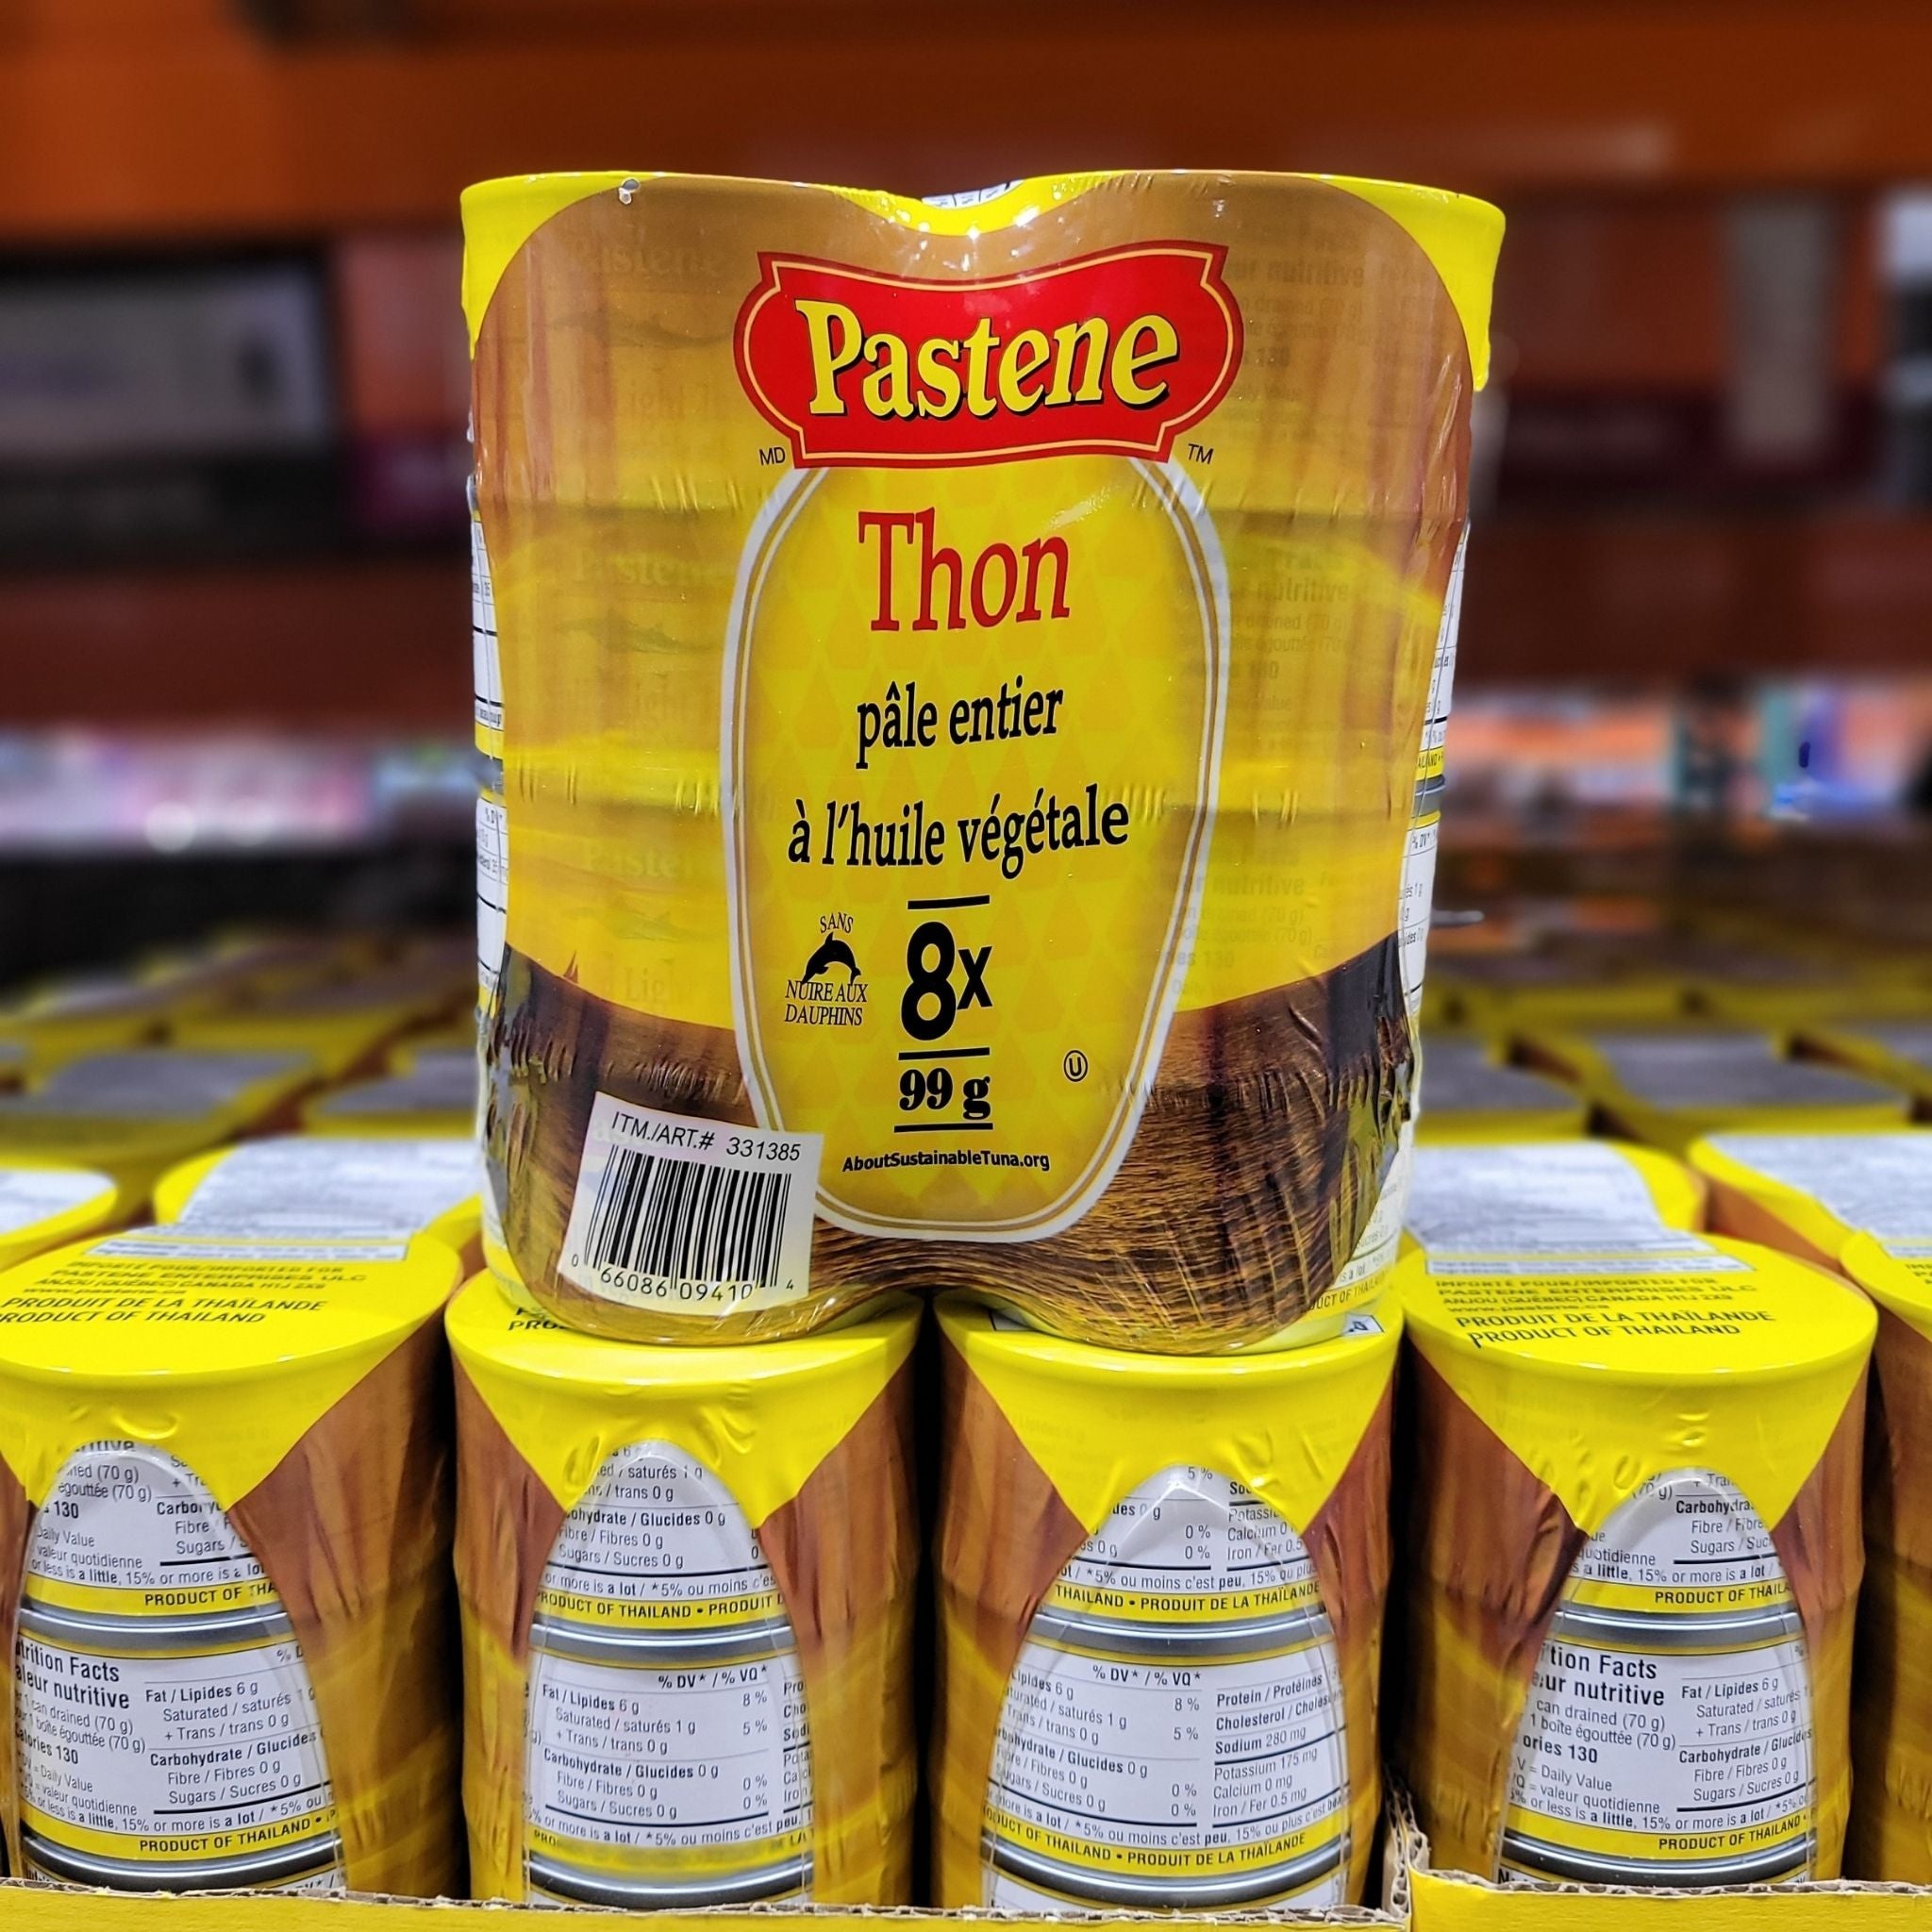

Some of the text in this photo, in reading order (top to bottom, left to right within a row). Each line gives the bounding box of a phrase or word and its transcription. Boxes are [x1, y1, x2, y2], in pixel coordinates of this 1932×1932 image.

[795, 299, 1179, 420] Pastene
[759, 446, 785, 465] MD
[1187, 444, 1213, 464] TM
[858, 507, 1070, 631] Thon
[856, 675, 1063, 769] pâle entier
[788, 783, 1129, 879] à l'huile végétale
[820, 912, 854, 933] SANS
[785, 979, 868, 1003] NUIRE AUX
[785, 1004, 862, 1025] DAUPHINS
[899, 1067, 991, 1121] 99 g
[611, 1111, 801, 1160] ITM./ART.# 331385
[842, 1149, 1049, 1173] AboutSustainableTuna.org
[572, 1254, 793, 1300] 0 66086 09410 4
[2, 1297, 326, 1311] PRODUIT DE LA THAÏLANDE
[106, 1312, 138, 1321] OF
[143, 1311, 266, 1323] THAILAND
[1457, 1310, 1775, 1327] PRODUIT DE LA THAÏLANDE
[1469, 1324, 1740, 1348] PRODUCT OF THAILAND
[627, 1466, 677, 1479] saturés
[616, 1486, 648, 1500] trans
[55, 1500, 79, 1519] 130
[641, 1511, 701, 1527] Glucides
[175, 1520, 209, 1534] Fibre
[600, 1529, 638, 1546] Fibres
[1227, 1521, 1275, 1541] Calcium
[1691, 1520, 1723, 1534] Fibre
[64, 1531, 94, 1547] Value
[176, 1540, 225, 1556] Sugars
[1690, 1540, 1735, 1556] Sugars
[72, 1553, 142, 1569] quotidienne
[558, 1544, 658, 1568] Sugars Sucres
[1227, 1543, 1252, 1560] Iron
[127, 1572, 213, 1584] 15% more
[1121, 1571, 1275, 1590] ou moins c'est 15%
[1639, 1569, 1666, 1582] 15%
[1672, 1572, 1687, 1583] or
[1690, 1568, 1722, 1582] more
[1726, 1567, 1736, 1580] is
[1740, 1568, 1746, 1579] a
[1750, 1565, 1765, 1578] lot
[145, 1585, 242, 1606] PRODUCT OF
[560, 1574, 748, 1596] more lot ou moins
[1056, 1581, 1320, 1611] THAILAND PRODUIT DE LA THAÏLANDE
[1656, 1590, 1744, 1604] PRODUCT OF
[597, 1596, 773, 1618] OF THAILAND PRODUIT
[71, 1657, 120, 1682] Facts
[1599, 1655, 1657, 1679] Facts
[54, 1683, 129, 1709] nutritive
[146, 1686, 232, 1703] Fat Lipides
[1216, 1674, 1323, 1707] Protein Protéines
[1574, 1680, 1664, 1706] nutritive
[1681, 1680, 1759, 1699] Fat Lipides
[50, 1707, 90, 1727] drained
[163, 1702, 228, 1723] Saturated
[556, 1707, 671, 1733] Saturated saturés
[1216, 1708, 1285, 1731] Cholesterol
[1565, 1706, 1617, 1725] drained
[1696, 1703, 1755, 1719] Saturated
[1541, 1716, 1632, 1747] boîte égouttée
[151, 1731, 316, 1767] Carbohydrate Glucides
[1215, 1731, 1286, 1755] Sodium 280
[56, 1745, 78, 1765] 130
[544, 1747, 693, 1778] Carbohydrate Glucides
[1068, 1750, 1124, 1774] Glucides
[1569, 1744, 1598, 1764] 130
[1679, 1745, 1761, 1764] Carbohydrate
[1214, 1753, 1300, 1781] Potassium 175
[1693, 1768, 1725, 1783] Fibre
[1541, 1764, 1612, 1792] Daily Value
[169, 1778, 276, 1807] Sugars Sucres
[1213, 1782, 1261, 1800] Calcium
[1540, 1785, 1659, 1814] valeur quotidienne
[1693, 1788, 1736, 1804] Sugars
[72, 1795, 137, 1816] quotidienne
[609, 1801, 653, 1818] Sucres
[1213, 1797, 1268, 1819] Iron Fer
[123, 1809, 256, 1832] 15% lot
[1641, 1817, 1724, 1830] 15% more
[141, 1820, 311, 1852] PRODUCT OF THAILAND
[701, 1821, 773, 1843] moins c'est
[1171, 1824, 1261, 1846] c'est 15%
[1658, 1814, 1801, 1850] PRODUCT OF THAILAND
[1046, 1832, 1306, 1866] THAILAND PRODUIT DE LA THAÏLANDE
